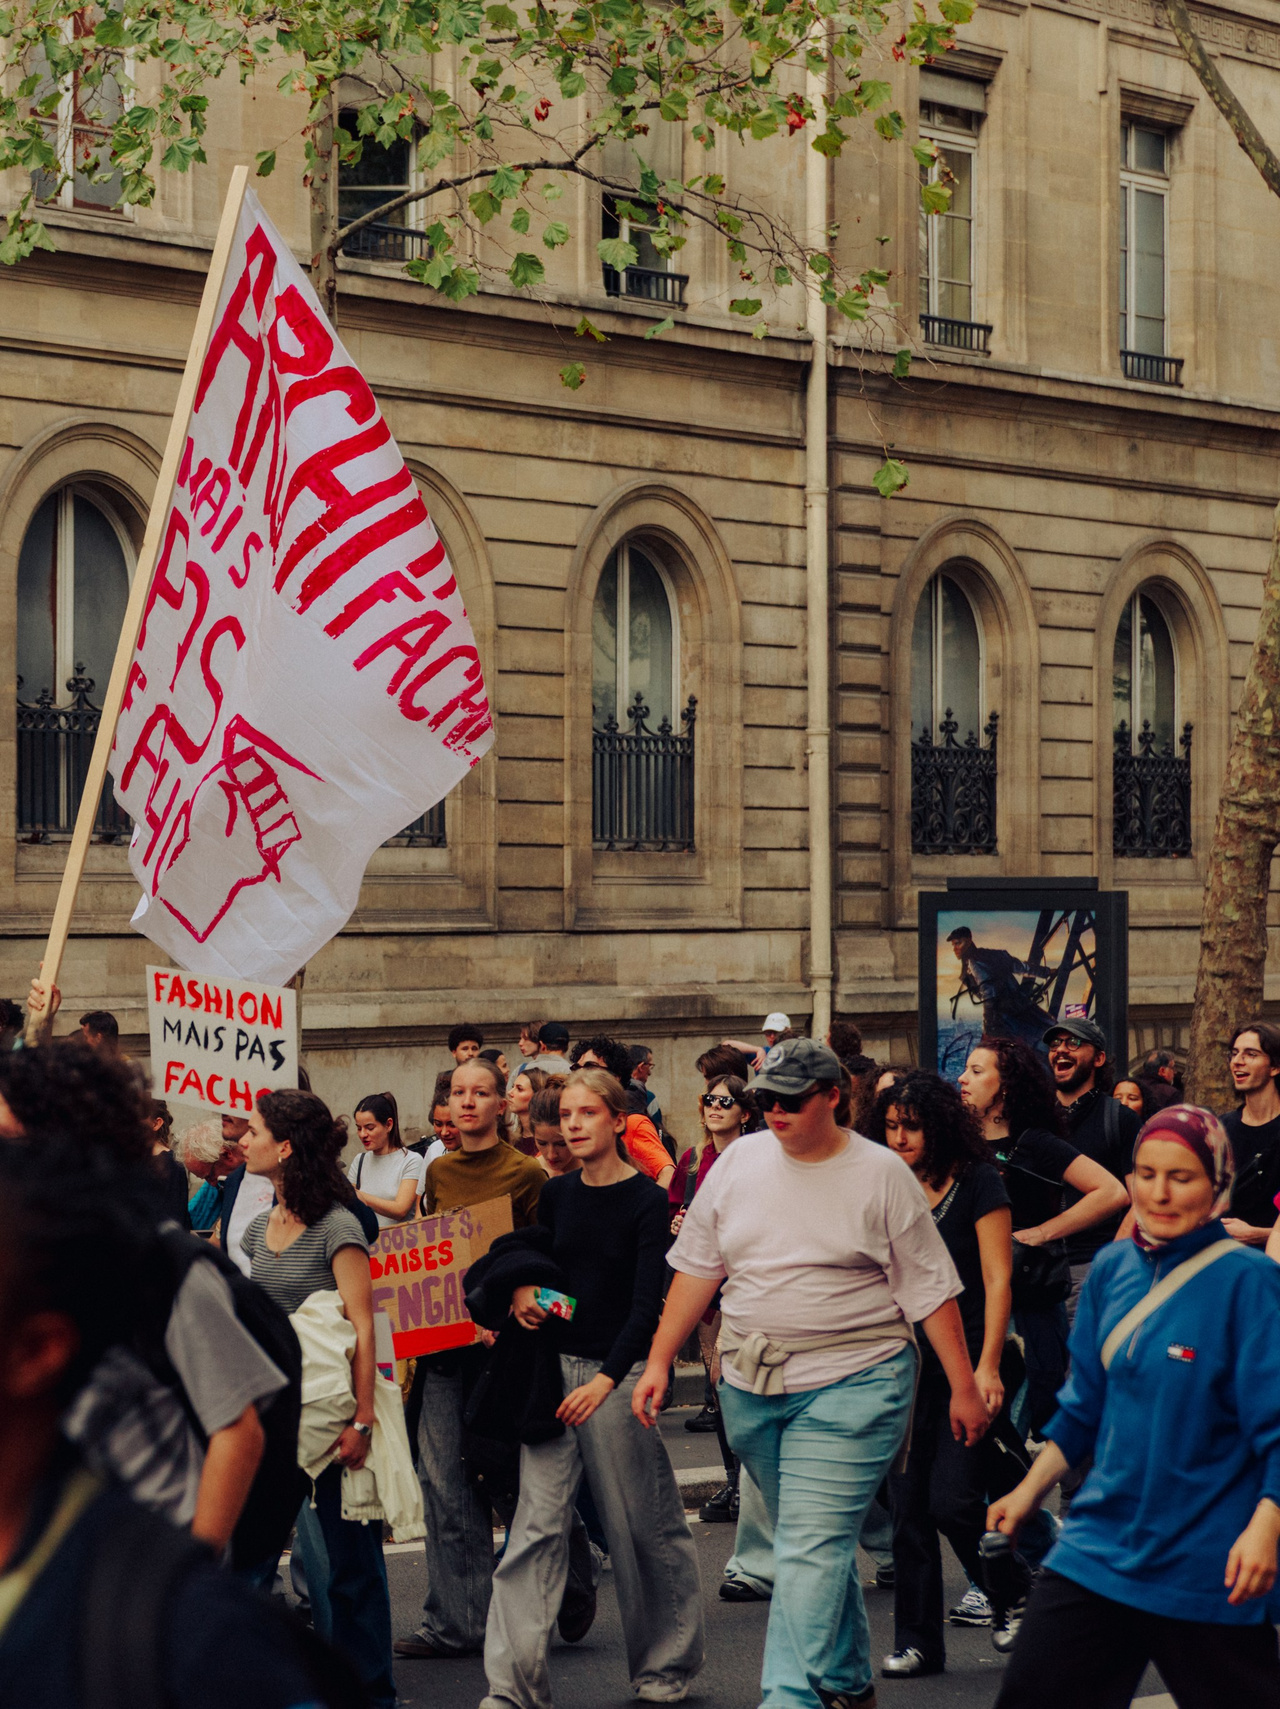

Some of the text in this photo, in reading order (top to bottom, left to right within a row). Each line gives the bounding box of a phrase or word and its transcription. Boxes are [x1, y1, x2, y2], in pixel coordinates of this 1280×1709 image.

[154, 971, 283, 1030] FASHION
[163, 1016, 286, 1072] MAIS PAS
